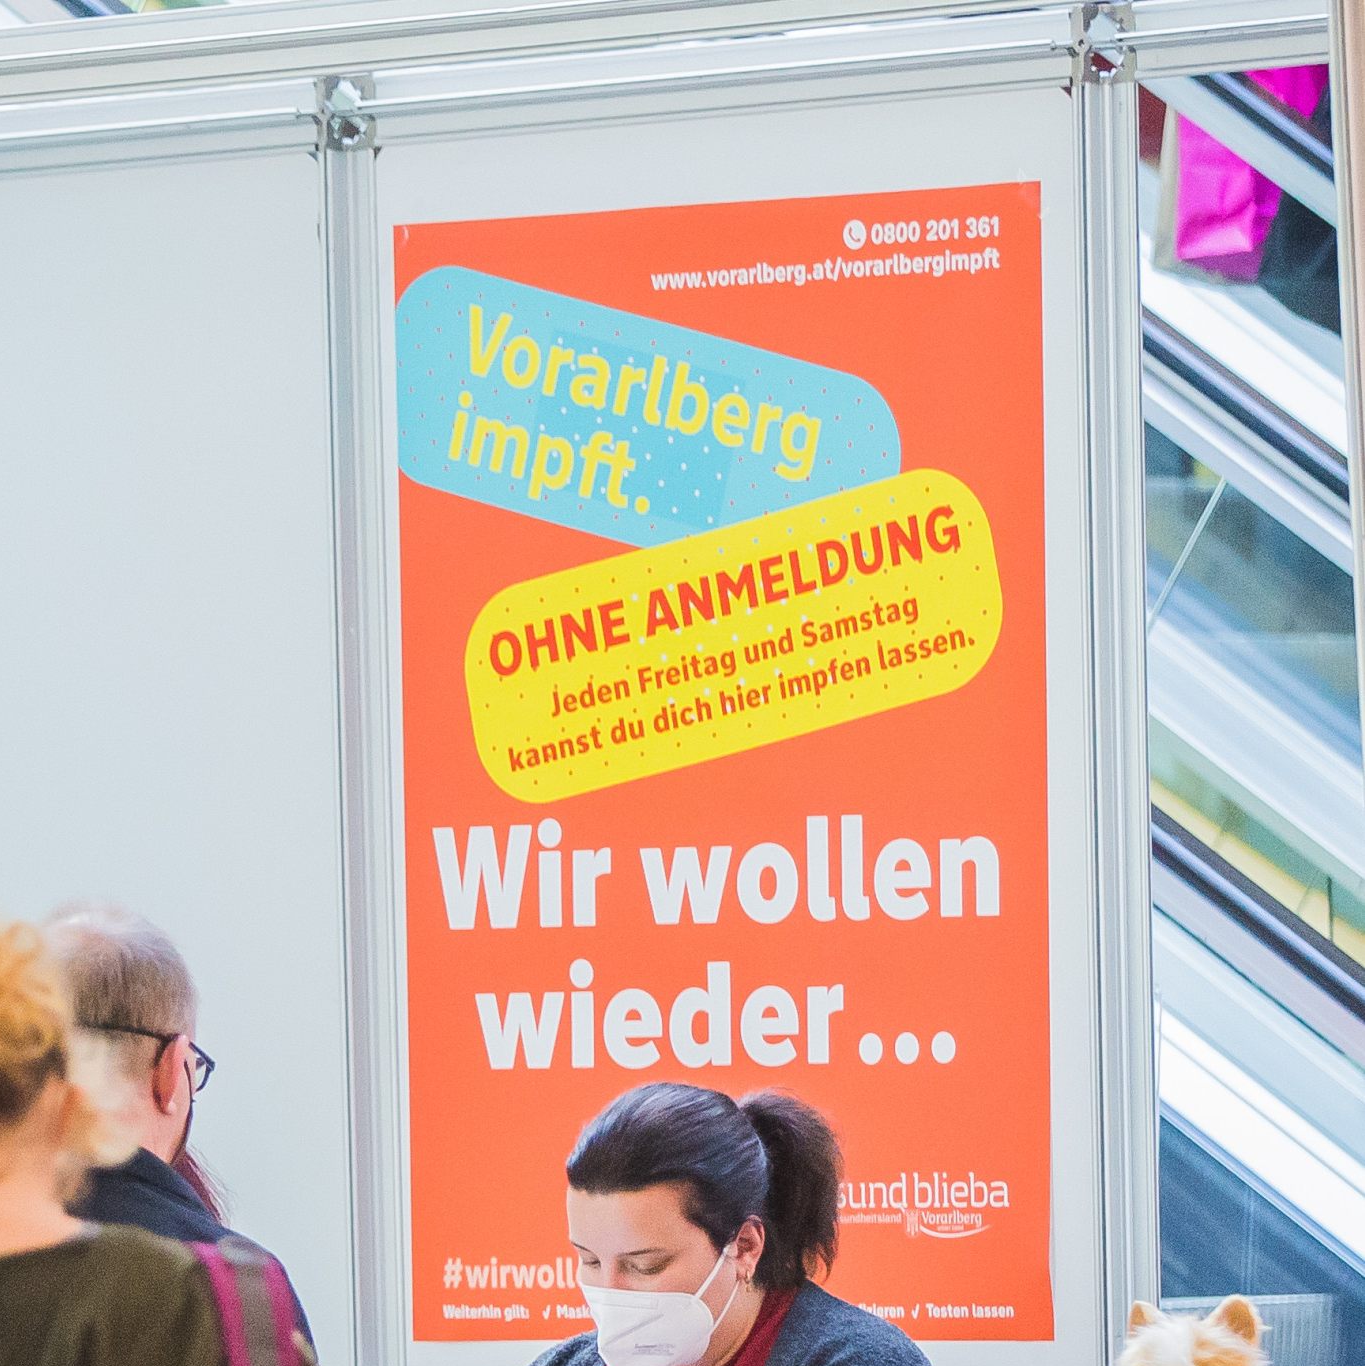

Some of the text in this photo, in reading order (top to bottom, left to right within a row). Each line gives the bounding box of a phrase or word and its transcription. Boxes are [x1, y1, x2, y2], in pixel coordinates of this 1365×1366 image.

[650, 247, 1001, 291] www.vorarlberg.at/vorarlbergimpft
[870, 216, 1000, 245] 0800 201 361
[468, 303, 823, 481] Vorarlberg
[447, 390, 650, 515] impft.
[489, 504, 962, 678] OHNE ANMELDUNG
[507, 628, 976, 772] kannst du dich hier impfen lassen.
[550, 597, 920, 718] Jeden Freitag und Samstag
[432, 813, 1002, 931] Wir wollen
[475, 957, 957, 1071] wieder...
[912, 1171, 1011, 1209] blieba
[921, 1210, 983, 1228] Vorarlberg
[442, 1256, 579, 1290] #wirwoll
[442, 1304, 502, 1320] Weiterhin
[504, 1303, 530, 1322] gilt:
[556, 1304, 592, 1320] Mask
[926, 1303, 969, 1319] Testen
[972, 1303, 1016, 1319] lassen
